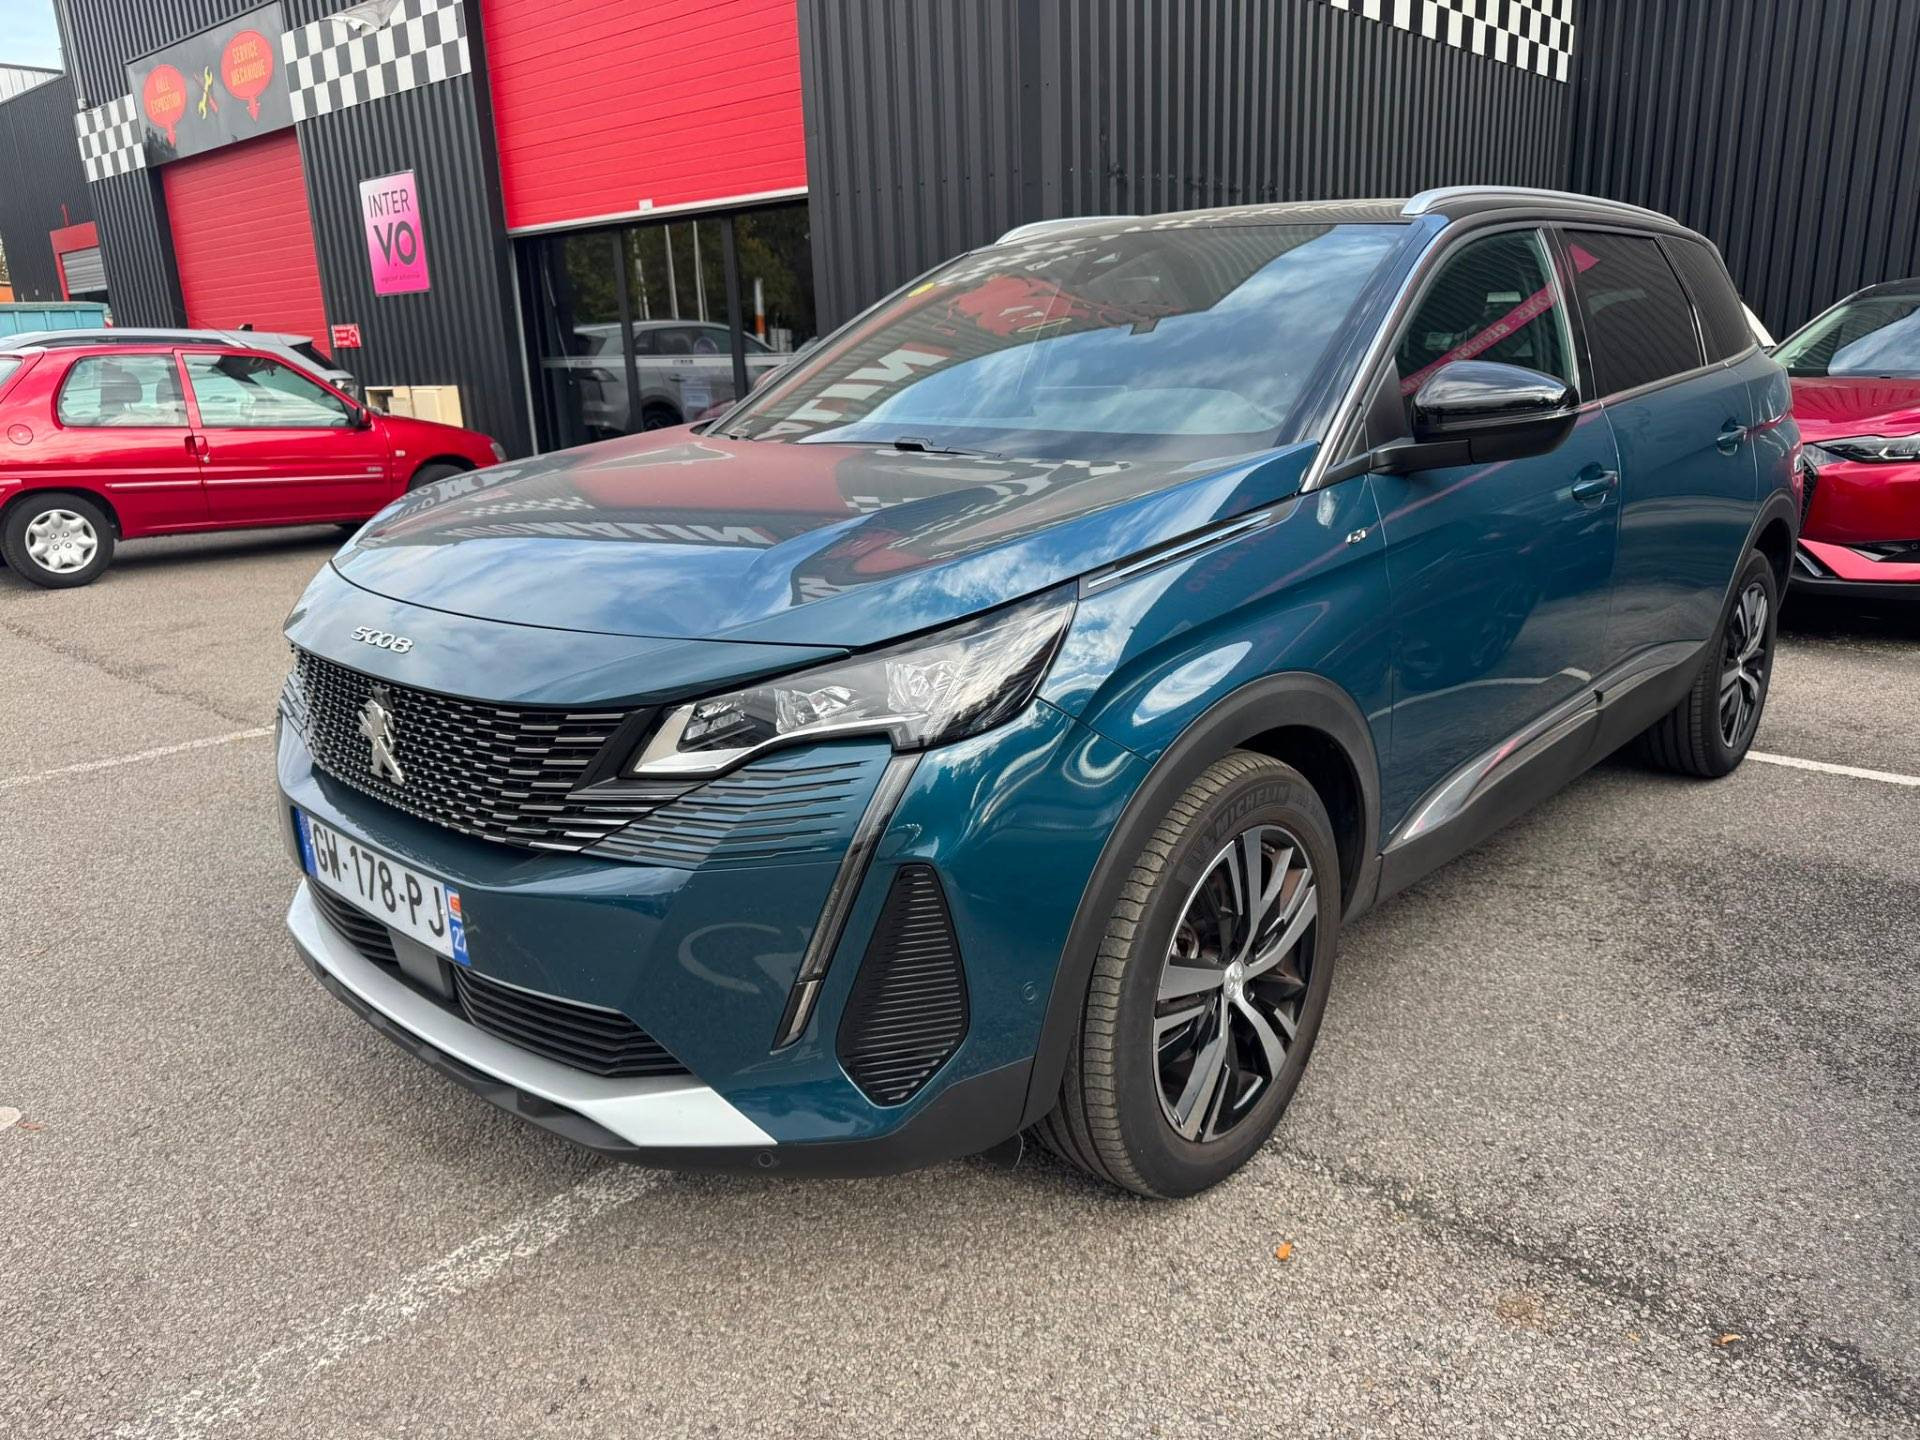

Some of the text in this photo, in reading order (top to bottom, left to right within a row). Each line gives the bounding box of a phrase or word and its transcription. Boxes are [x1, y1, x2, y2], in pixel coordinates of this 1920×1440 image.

[368, 189, 410, 218] INTER
[350, 625, 413, 653] 5008
[1214, 785, 1289, 839] MICHELIN
[313, 823, 444, 938] GW-178-PJ
